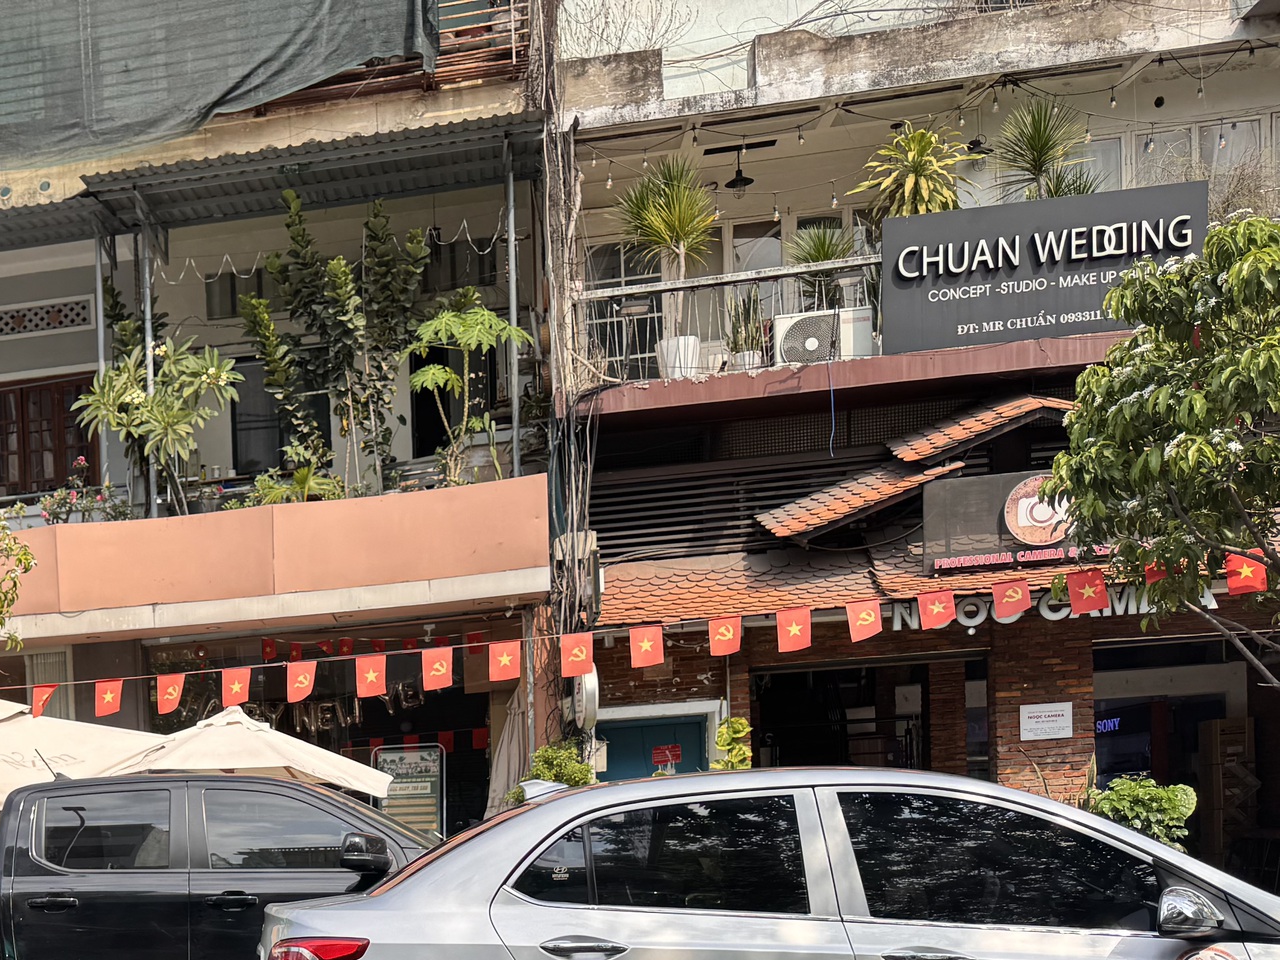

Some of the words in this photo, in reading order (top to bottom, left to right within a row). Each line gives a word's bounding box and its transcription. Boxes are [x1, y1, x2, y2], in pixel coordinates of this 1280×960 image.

[897, 235, 1020, 279] CHUAN
[1034, 214, 1193, 264] WEDDING
[928, 284, 992, 302] CONCEPT
[1059, 272, 1097, 288] MAKE
[1100, 270, 1117, 284] UP
[957, 323, 979, 336] ĐT:
[982, 320, 1004, 334] MR
[1007, 310, 1057, 330] CHUẨN
[935, 552, 1013, 569] PROFESSIONAL
[1017, 548, 1065, 562] CAMERA
[1096, 717, 1120, 733] SONY
